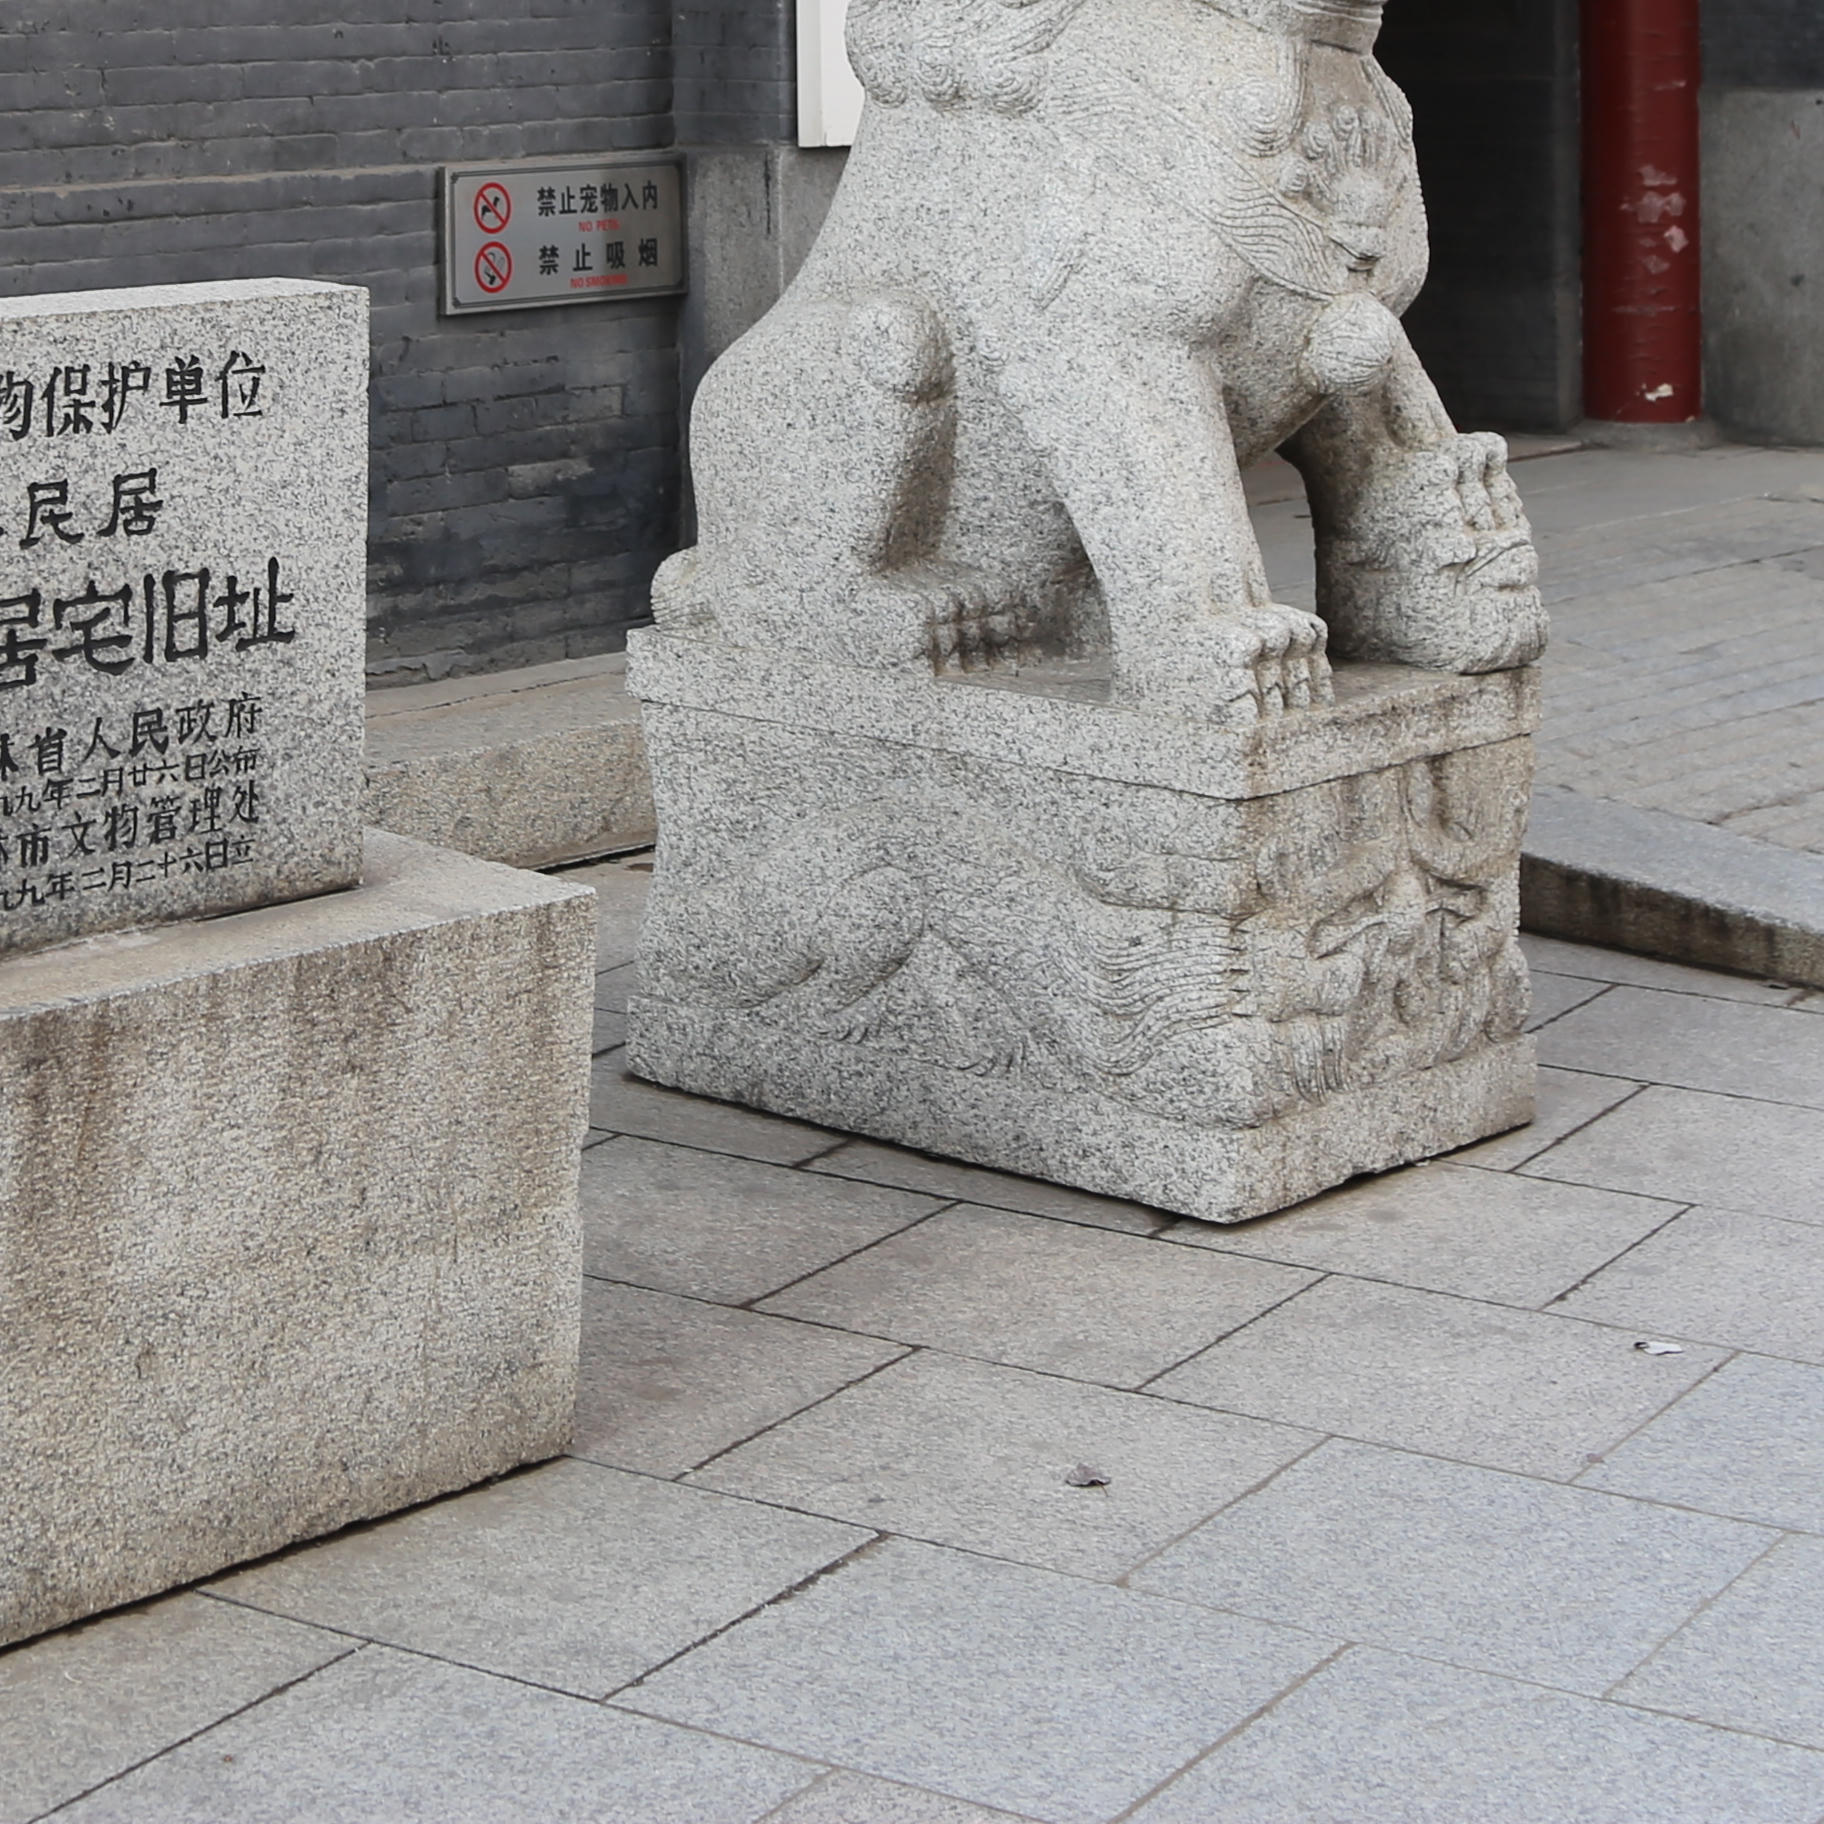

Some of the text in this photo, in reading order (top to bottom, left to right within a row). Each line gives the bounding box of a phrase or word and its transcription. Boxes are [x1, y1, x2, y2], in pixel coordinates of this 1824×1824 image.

[537, 180, 659, 217] 禁止宠物入内
[578, 221, 593, 232] NO
[539, 238, 658, 275] 禁止吸烟
[570, 278, 584, 288] NO
